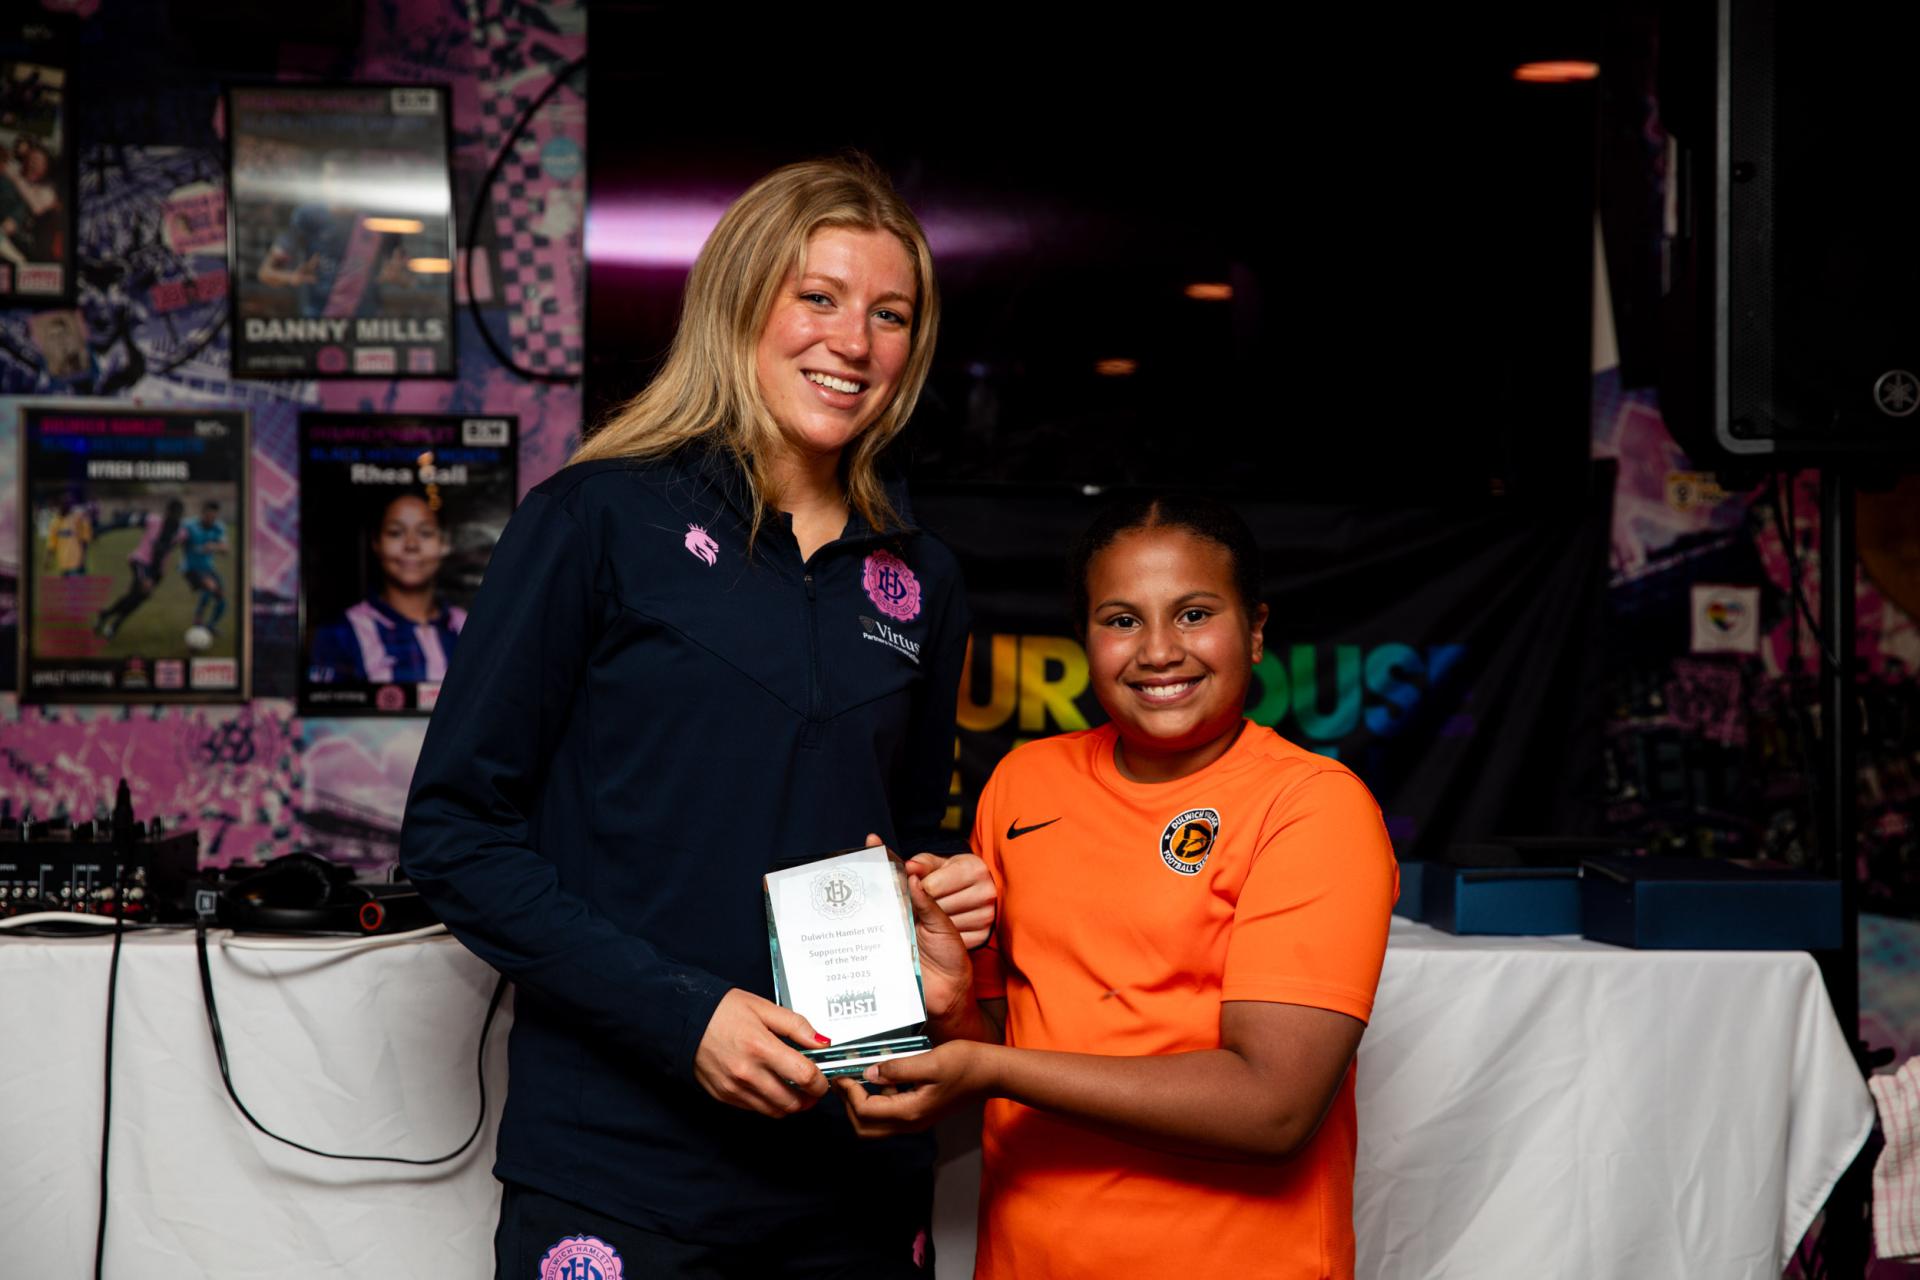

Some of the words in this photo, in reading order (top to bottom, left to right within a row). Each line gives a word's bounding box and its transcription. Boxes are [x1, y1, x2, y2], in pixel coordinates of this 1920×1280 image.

[245, 318, 348, 342] DANNY
[356, 318, 444, 342] MILLS
[875, 621, 920, 655] Virtus
[955, 633, 1091, 732] UR
[1171, 810, 1204, 829] DULWICH
[1163, 850, 1194, 872] FOOTBALL
[801, 932, 834, 942] Dulwich
[835, 927, 865, 938] Hamlet
[866, 924, 885, 934] WFC
[808, 945, 855, 958] Supporters
[855, 943, 881, 953] Player
[824, 956, 833, 966] of
[834, 956, 849, 965] the
[850, 954, 868, 963] Year
[826, 969, 872, 982] 2024-2025
[830, 998, 876, 1017] DHST
[576, 1245, 610, 1266] HAMLET
